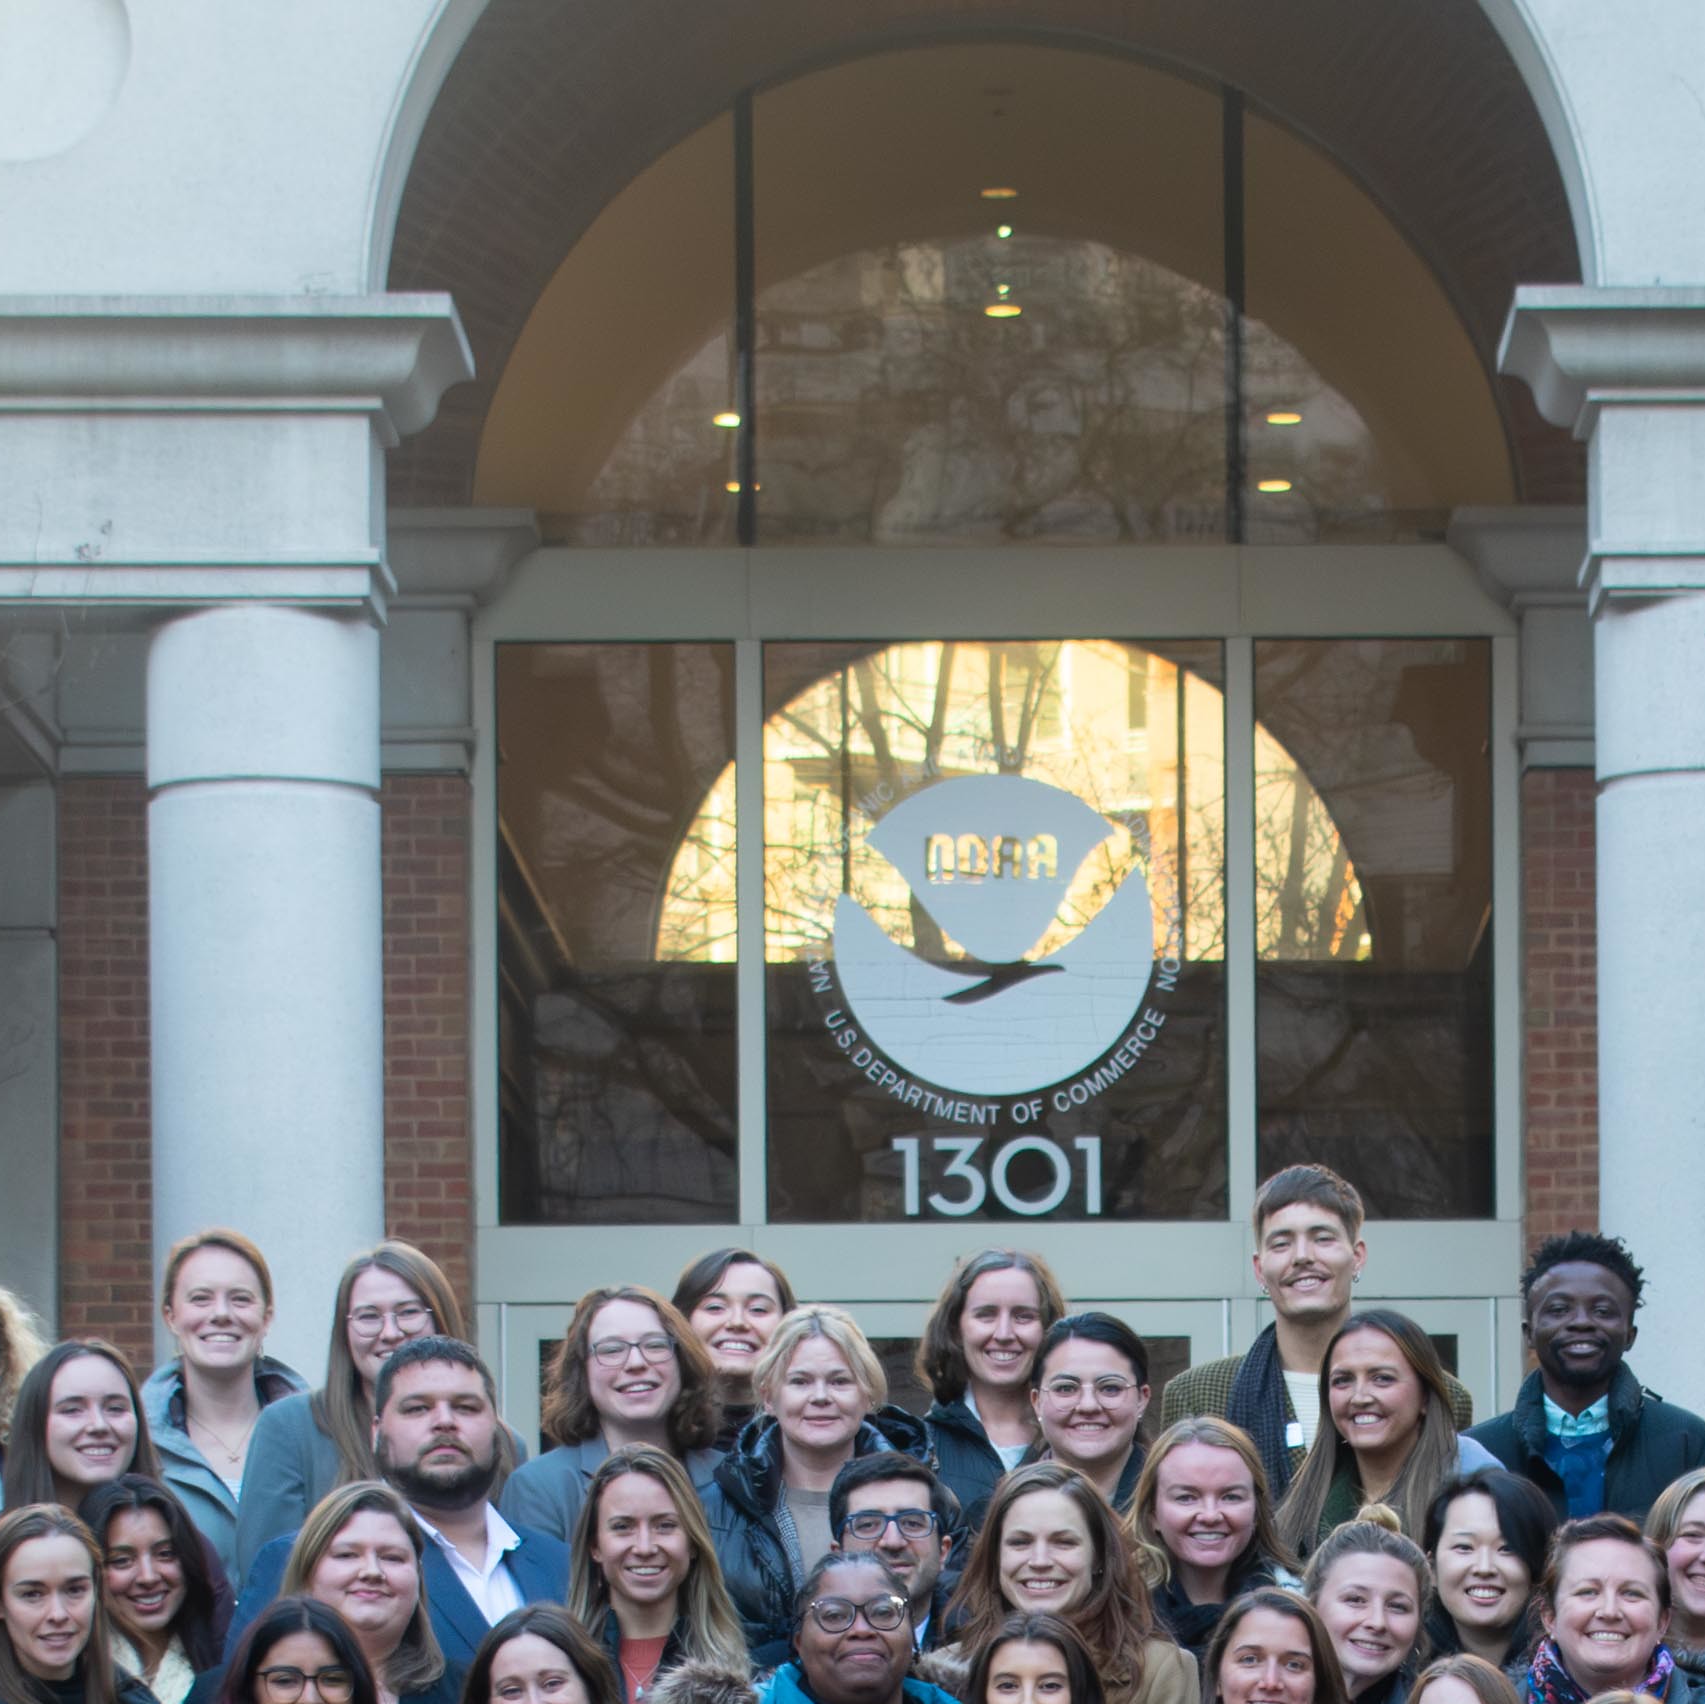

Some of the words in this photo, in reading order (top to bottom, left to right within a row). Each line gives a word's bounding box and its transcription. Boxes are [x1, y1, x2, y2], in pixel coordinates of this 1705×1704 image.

[925, 832, 1059, 880] NOAA
[853, 1046, 1001, 1125] DEPARTMENT
[1012, 1099, 1044, 1124] OF
[1054, 1008, 1166, 1112] COMMERCE
[894, 1136, 1101, 1216] 1301
